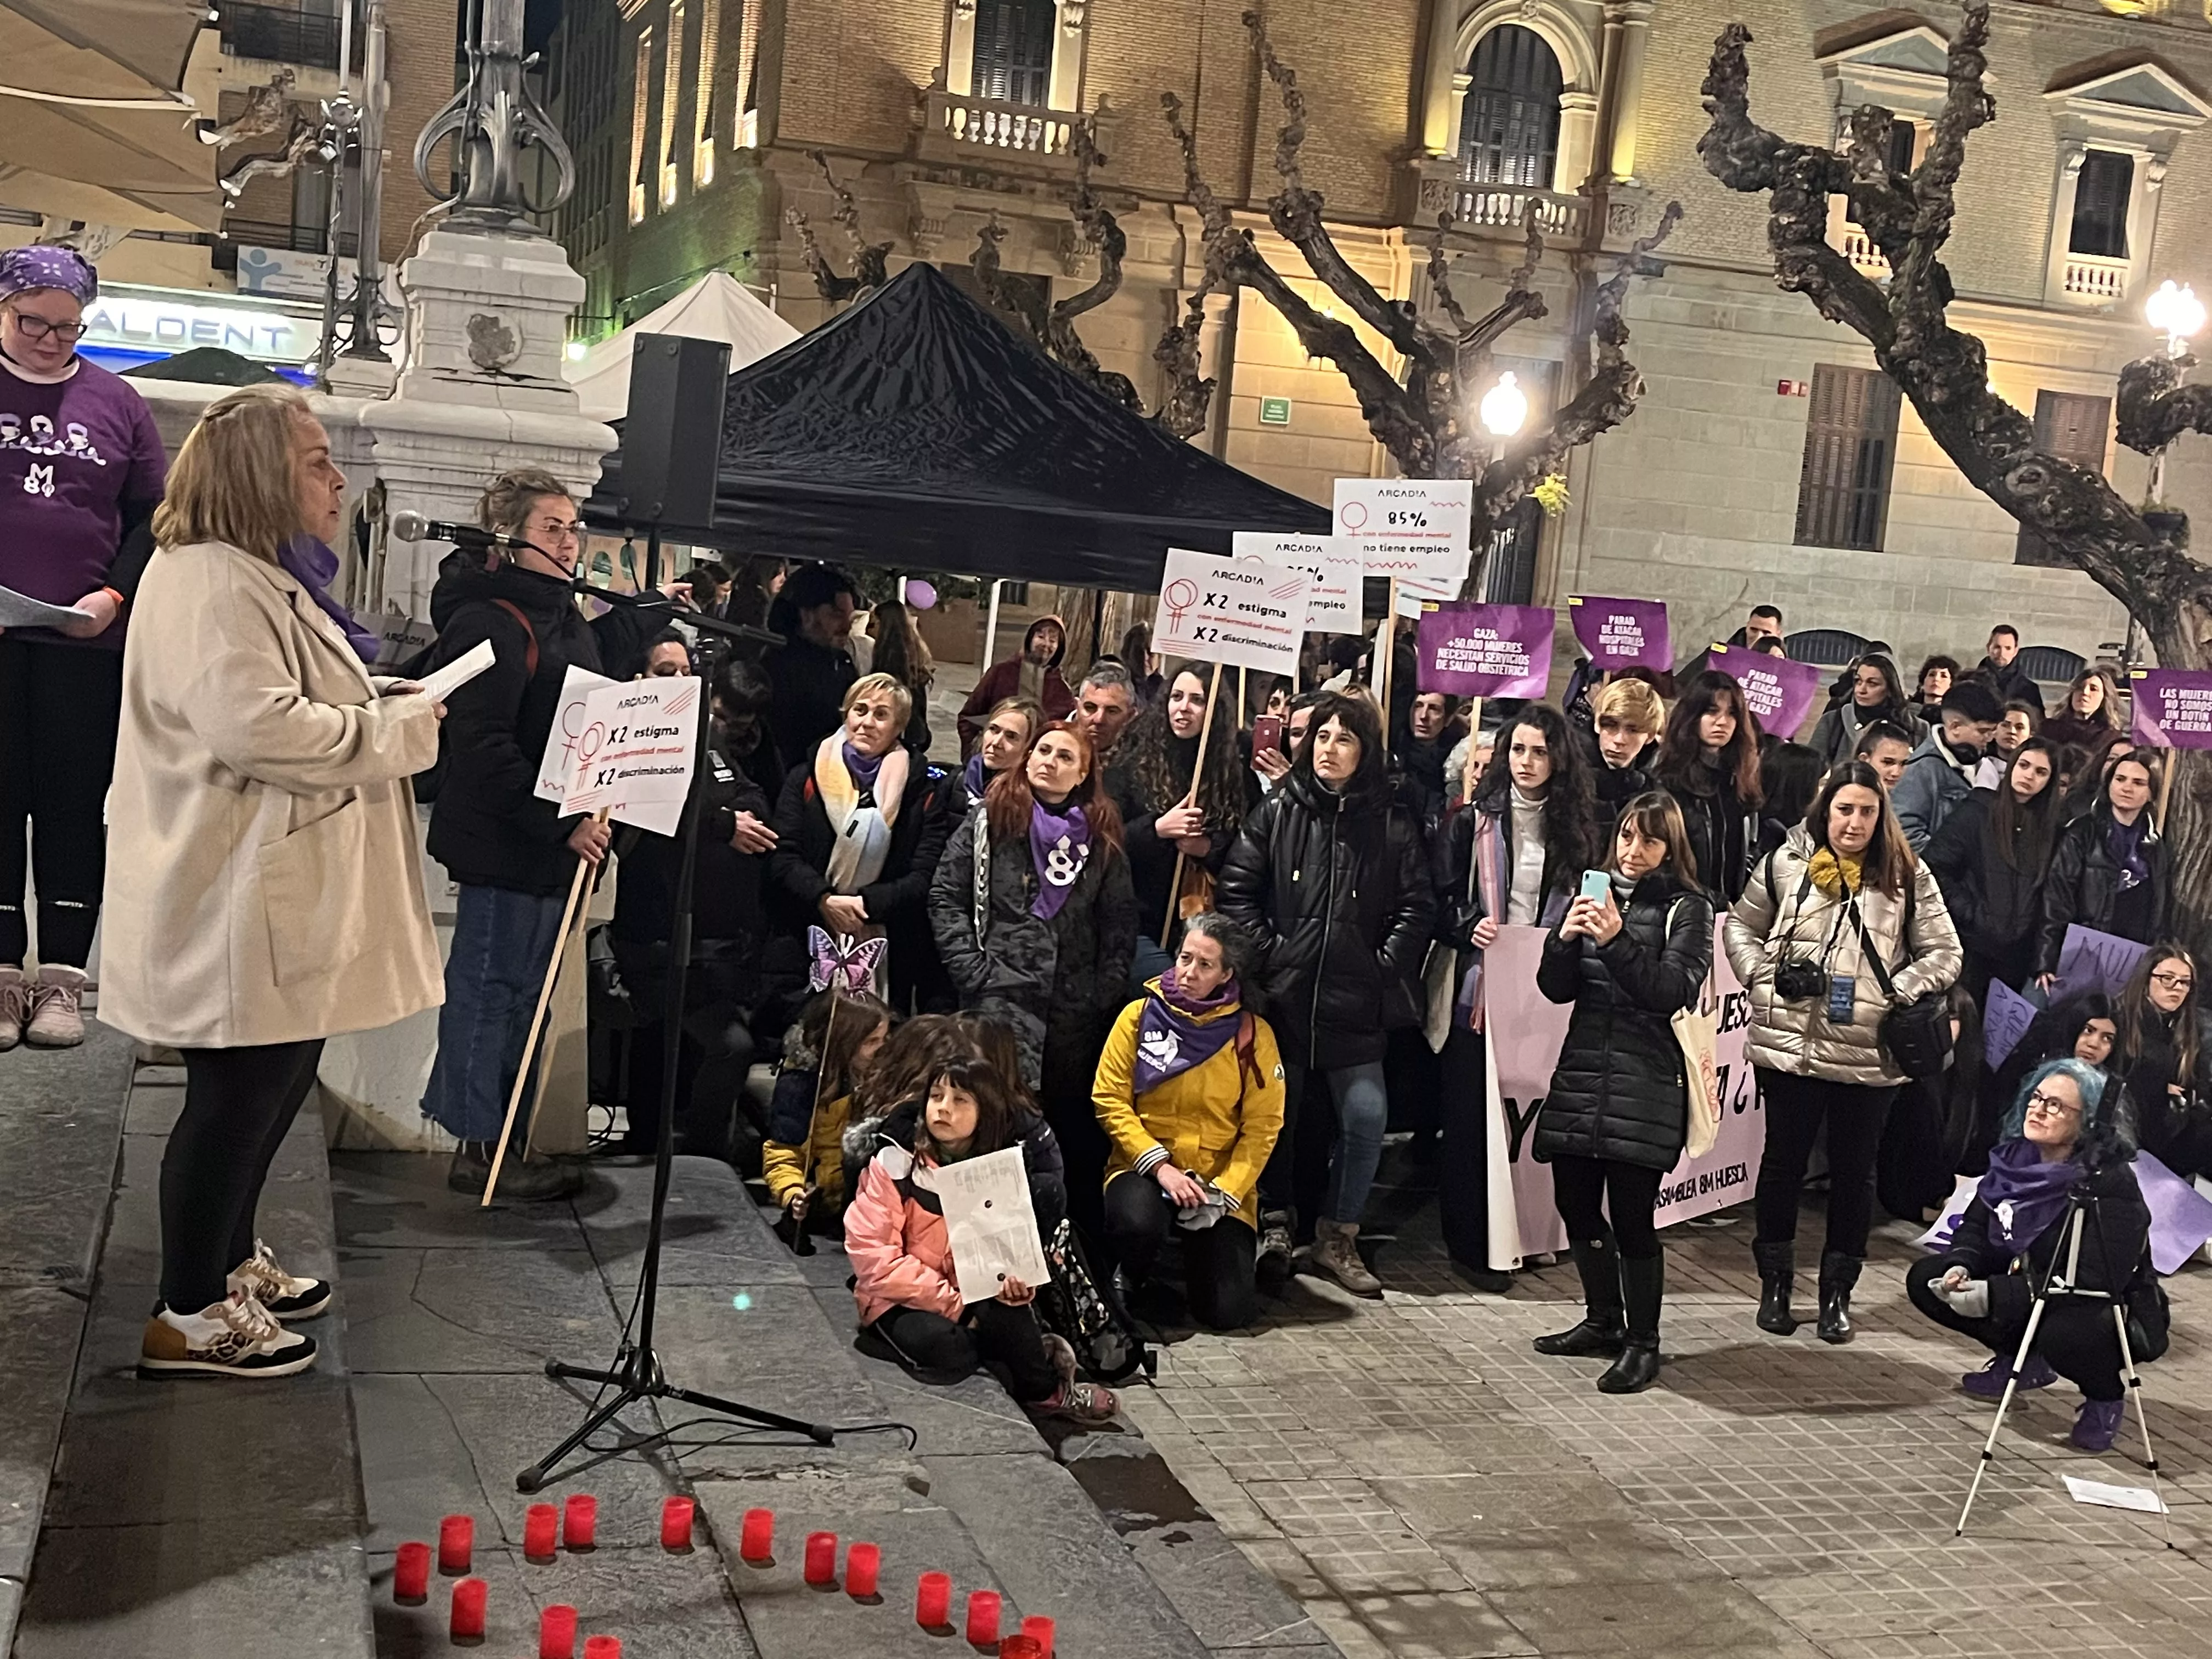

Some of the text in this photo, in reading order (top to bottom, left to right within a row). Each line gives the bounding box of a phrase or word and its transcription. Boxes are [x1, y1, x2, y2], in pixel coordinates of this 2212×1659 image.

[1388, 511, 1427, 527] 85%
[1380, 543, 1406, 552] tiene
[1410, 544, 1450, 554] empleo
[1238, 602, 1287, 618] estigma
[1222, 633, 1293, 653] discriminación
[1437, 648, 1530, 665] NECESITAN SERVICIOS
[1436, 659, 1447, 670] DE
[1449, 660, 1476, 673] SALUD
[1749, 681, 1784, 698] ATACAR
[2159, 687, 2177, 699] LAS
[2164, 699, 2178, 709] NO
[634, 725, 679, 738] estigma
[2159, 719, 2212, 732] DE GUERRA
[1144, 1031, 1163, 1042] 8M
[1700, 1172, 1714, 1194] 8M
[1715, 1161, 1748, 1190] HUESCA
